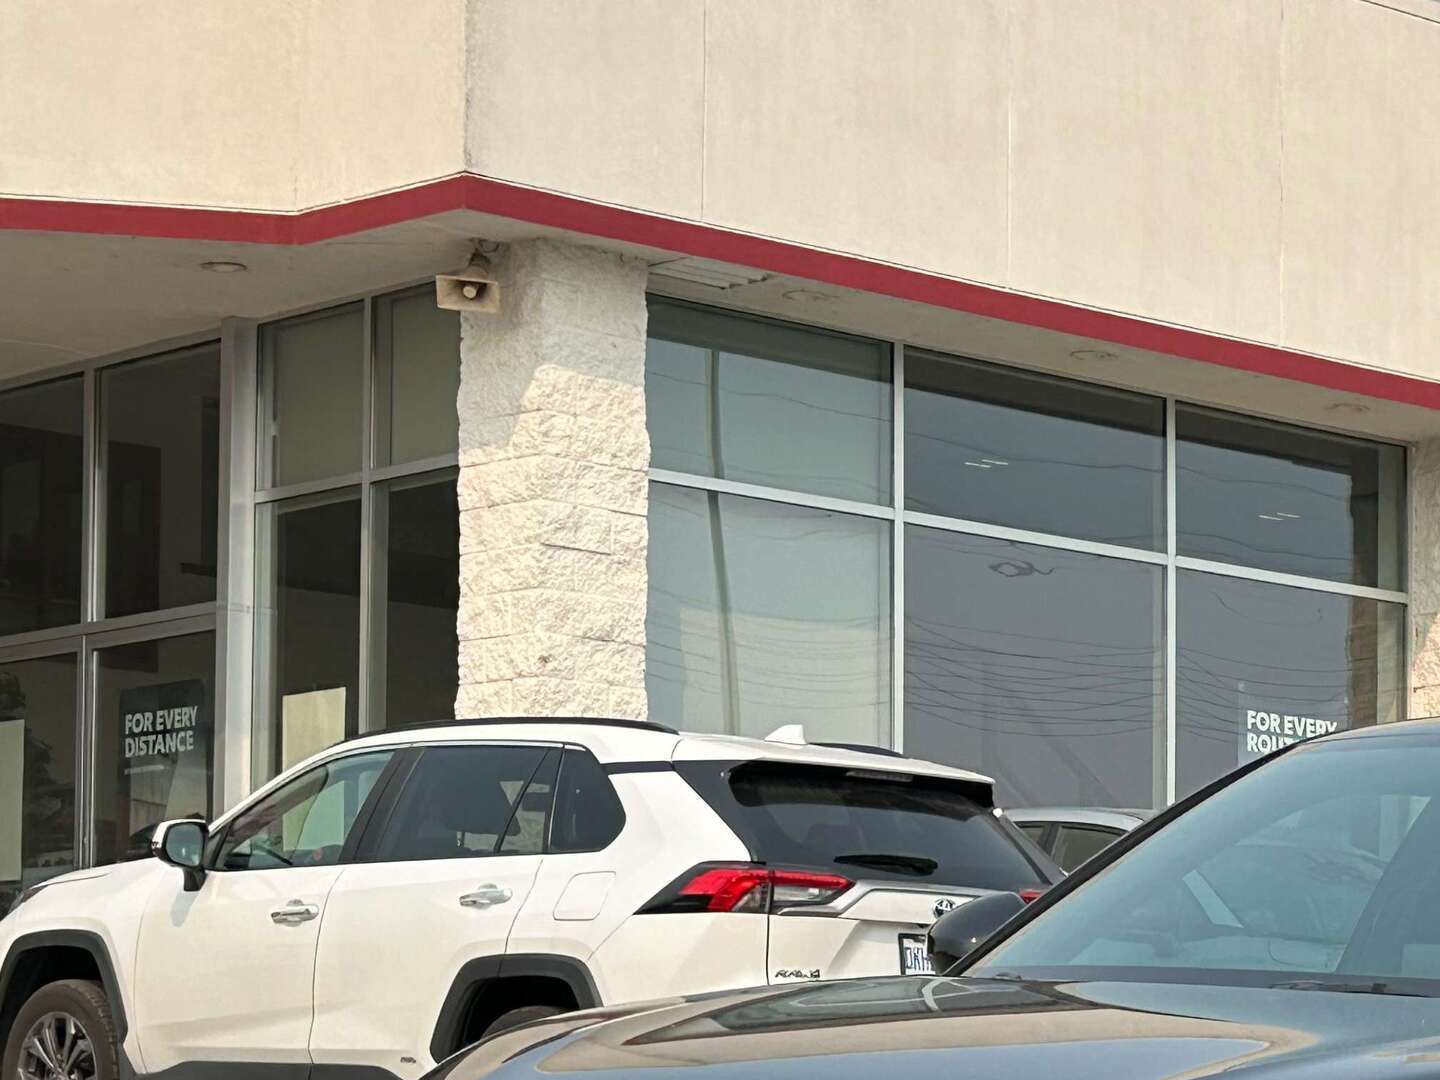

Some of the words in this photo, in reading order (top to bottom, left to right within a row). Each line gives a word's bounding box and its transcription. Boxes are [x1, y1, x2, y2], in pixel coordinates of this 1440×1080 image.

[125, 712, 153, 734] FOR
[156, 706, 198, 730] EVERY
[1247, 709, 1281, 734] FOR
[1284, 715, 1337, 738] EVERY
[125, 731, 194, 757] DISTANCE
[1247, 732, 1301, 754] ROUT
